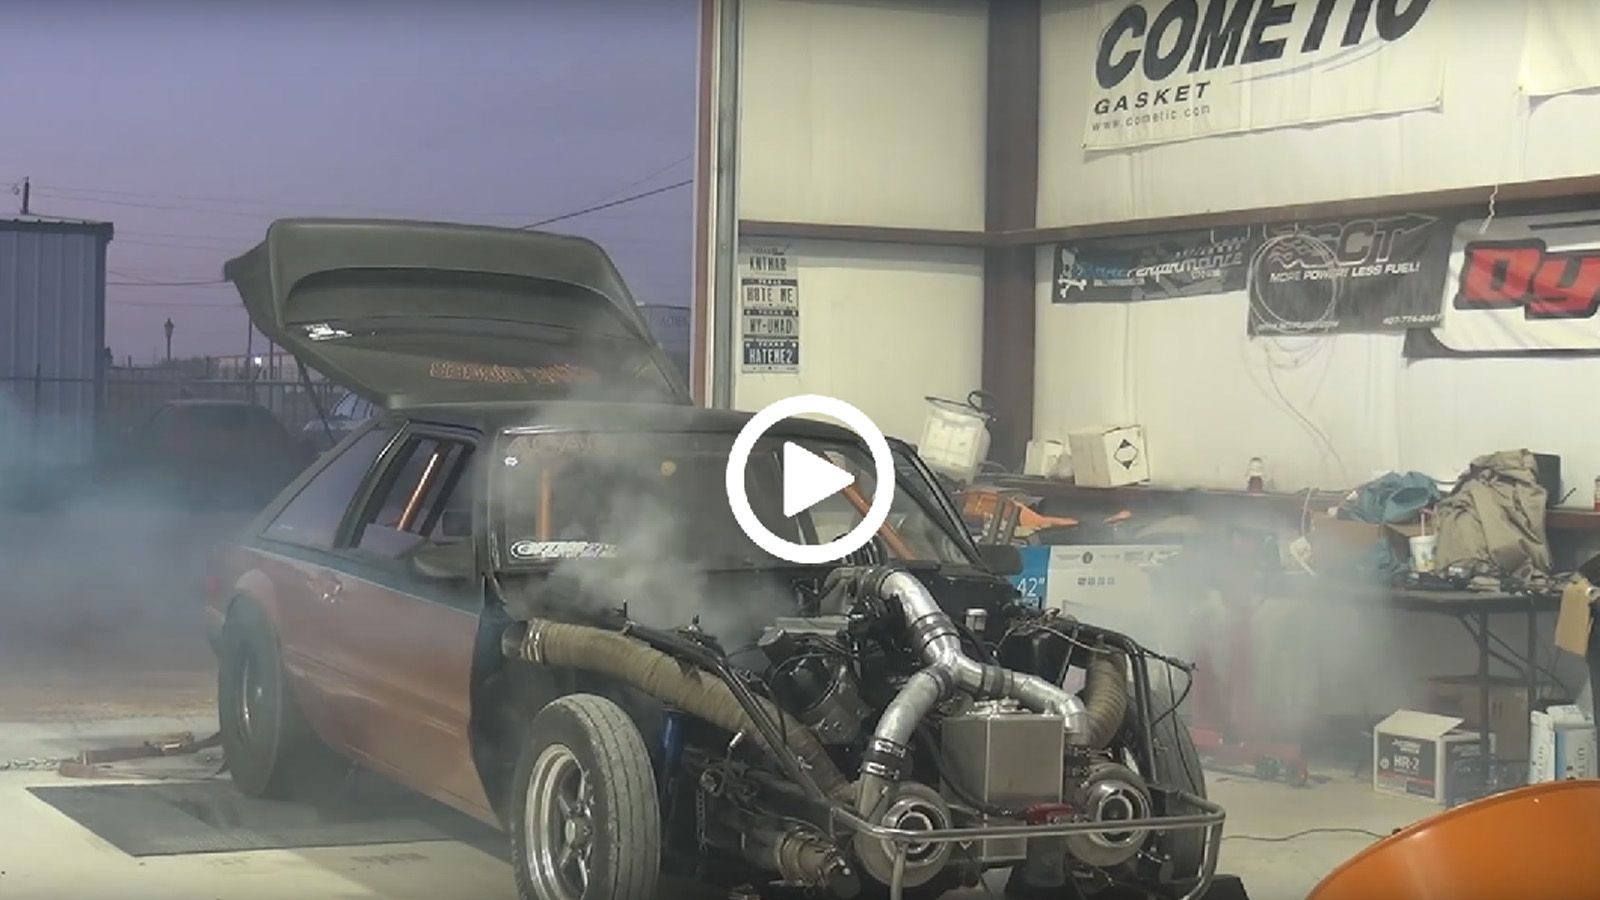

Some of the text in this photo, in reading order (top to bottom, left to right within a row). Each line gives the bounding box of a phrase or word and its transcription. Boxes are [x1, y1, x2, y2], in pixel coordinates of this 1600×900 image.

[1094, 80, 1211, 115] GASKET
[1351, 266, 1382, 277] LESS
[1384, 262, 1420, 275] FUEL!
